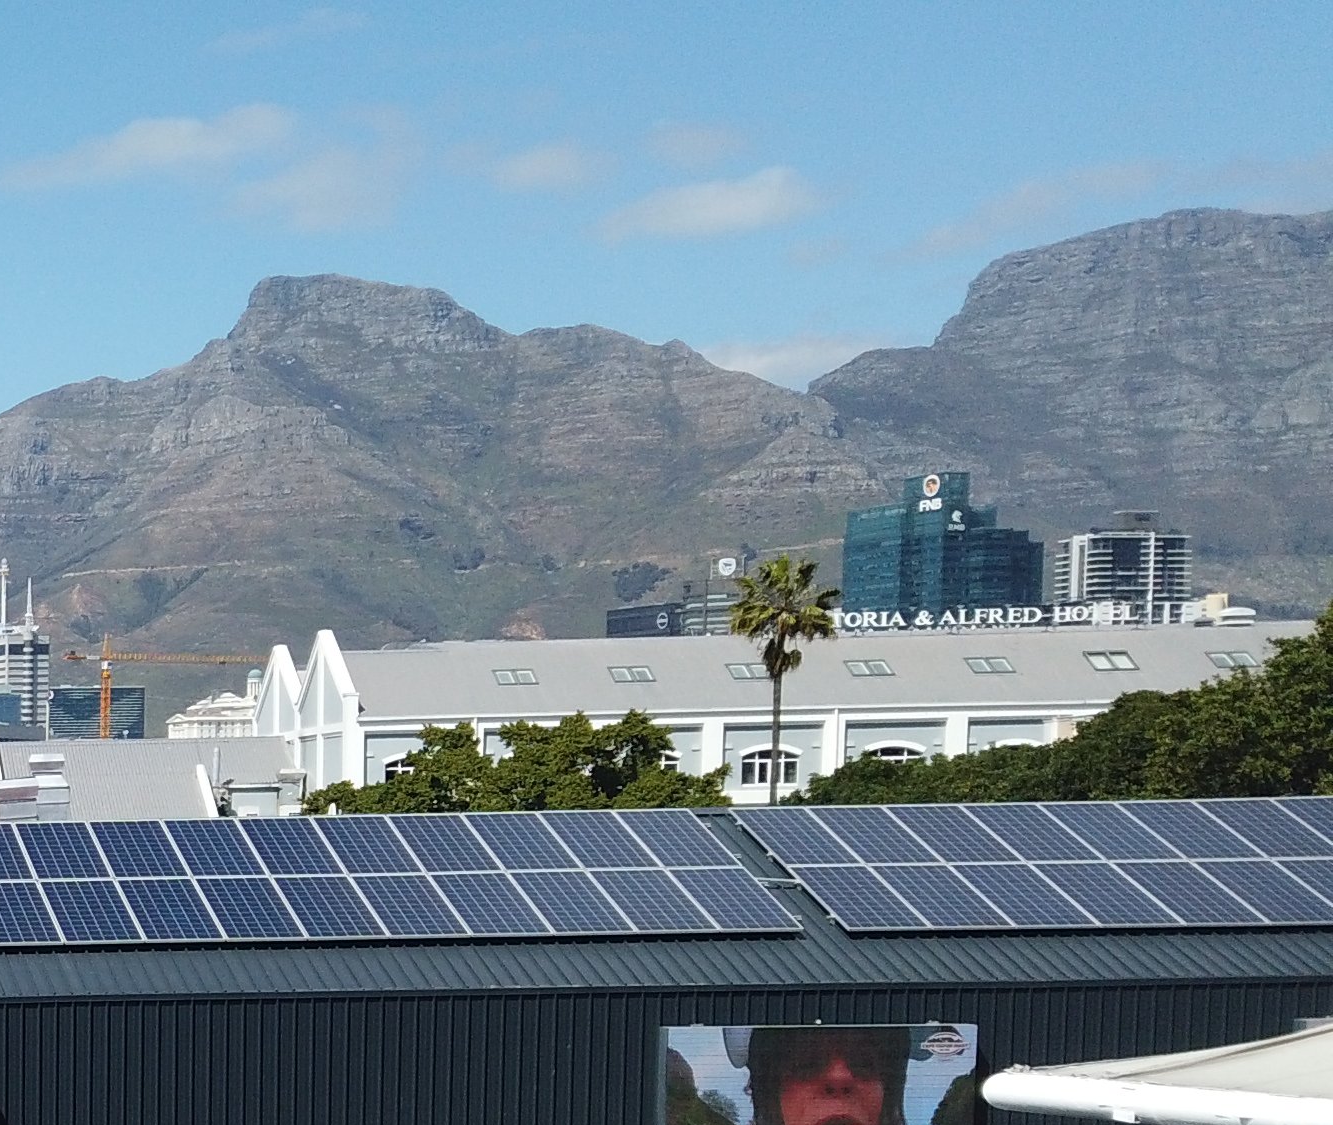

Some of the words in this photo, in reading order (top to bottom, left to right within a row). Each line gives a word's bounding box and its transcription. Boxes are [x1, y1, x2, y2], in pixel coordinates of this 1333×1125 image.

[919, 497, 943, 512] FNB
[832, 610, 907, 628] TORIA
[914, 609, 935, 626] &
[938, 606, 1043, 626] ALFRED
